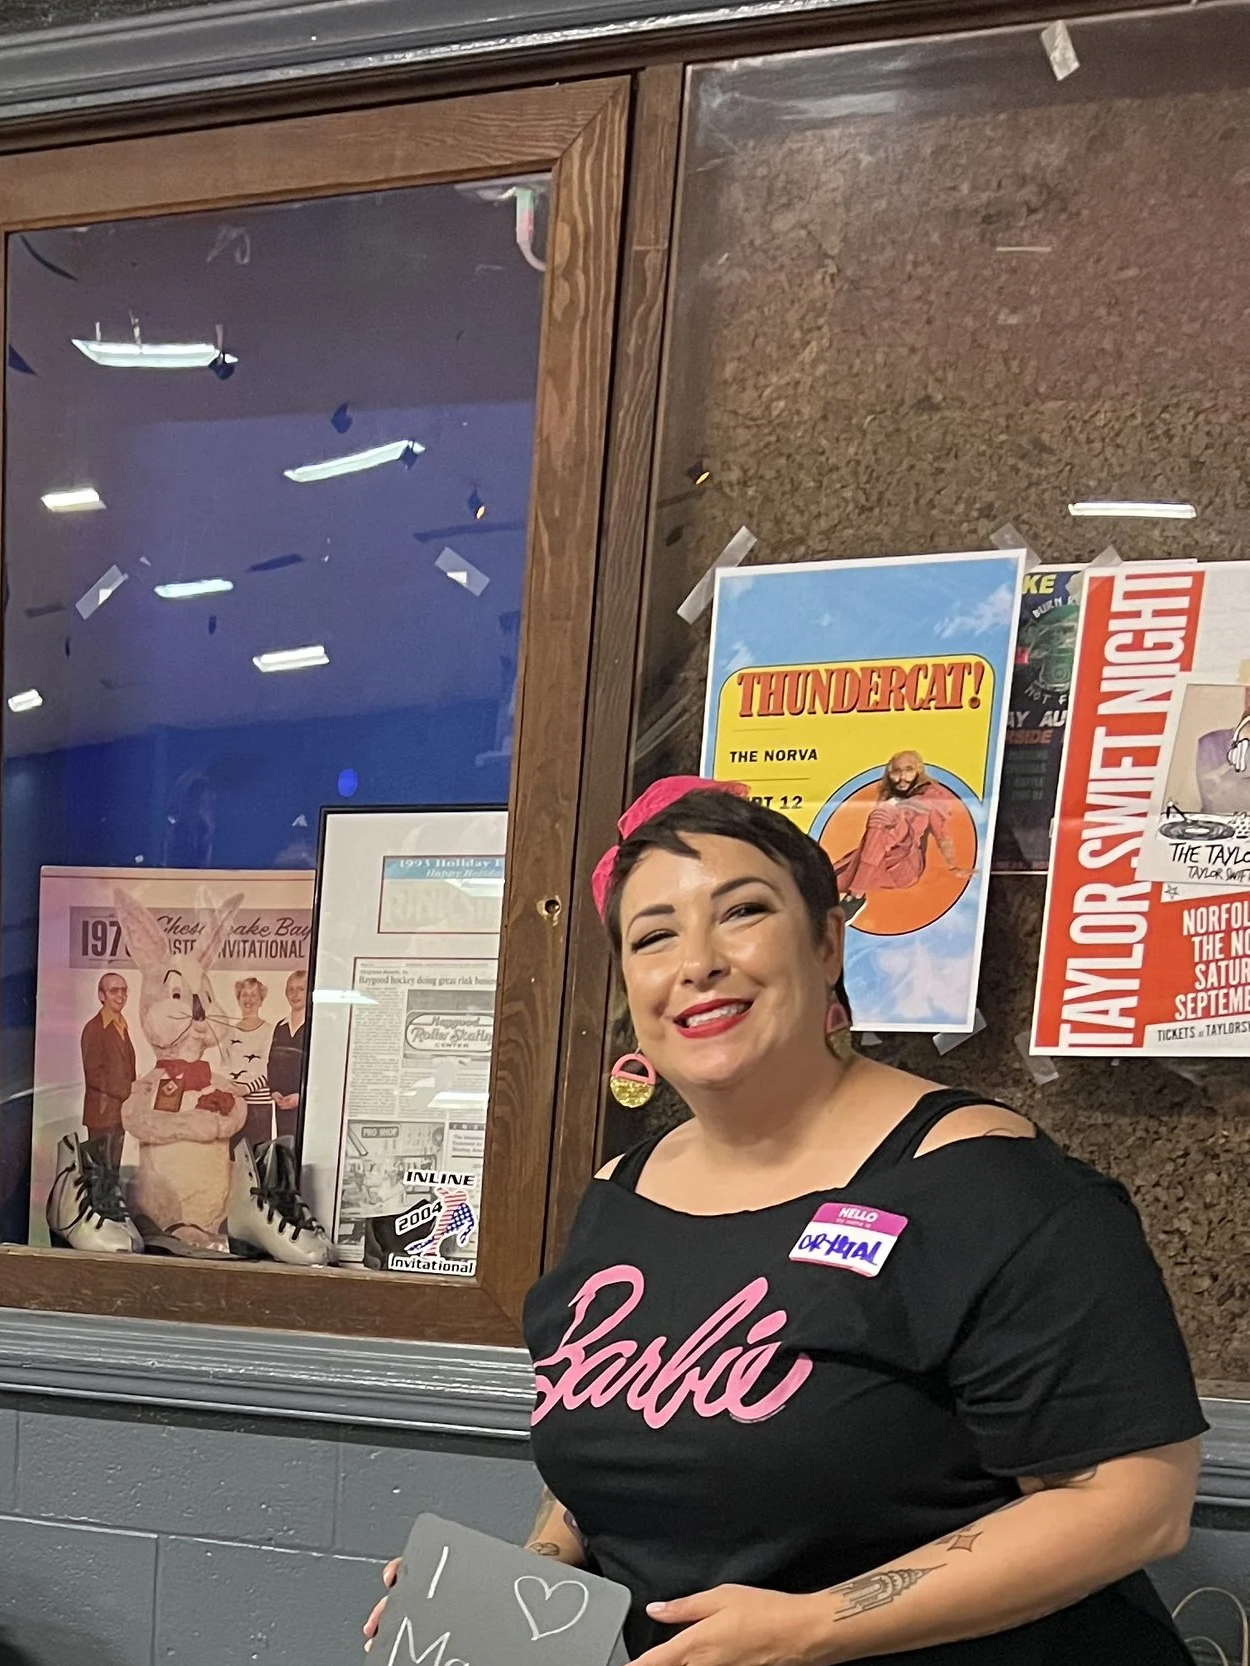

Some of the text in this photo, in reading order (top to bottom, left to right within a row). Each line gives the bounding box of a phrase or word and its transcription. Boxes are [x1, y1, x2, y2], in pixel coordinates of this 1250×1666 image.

[737, 661, 985, 717] THUNDERCAT!
[730, 749, 818, 763] THE NORVA
[779, 795, 803, 809] 12
[1078, 726, 1162, 870] SWIFT
[1169, 842, 1250, 866] THE TAYLO
[1188, 866, 1223, 879] TAYLOR
[82, 920, 131, 957] 197
[274, 916, 313, 940] Bay
[218, 938, 305, 959] NVITATIONAL
[1192, 933, 1224, 962] THE
[1058, 880, 1152, 1048] TAYLOR
[1158, 1027, 1195, 1041] TICKETS
[1206, 1021, 1250, 1036] TAYLORS
[406, 1171, 475, 1186] INLINE
[398, 1201, 442, 1232] 2004
[838, 1207, 878, 1222] HELLO
[390, 1256, 474, 1274] Invitational
[531, 1264, 814, 1429] Barbie
[427, 1546, 449, 1599] I
